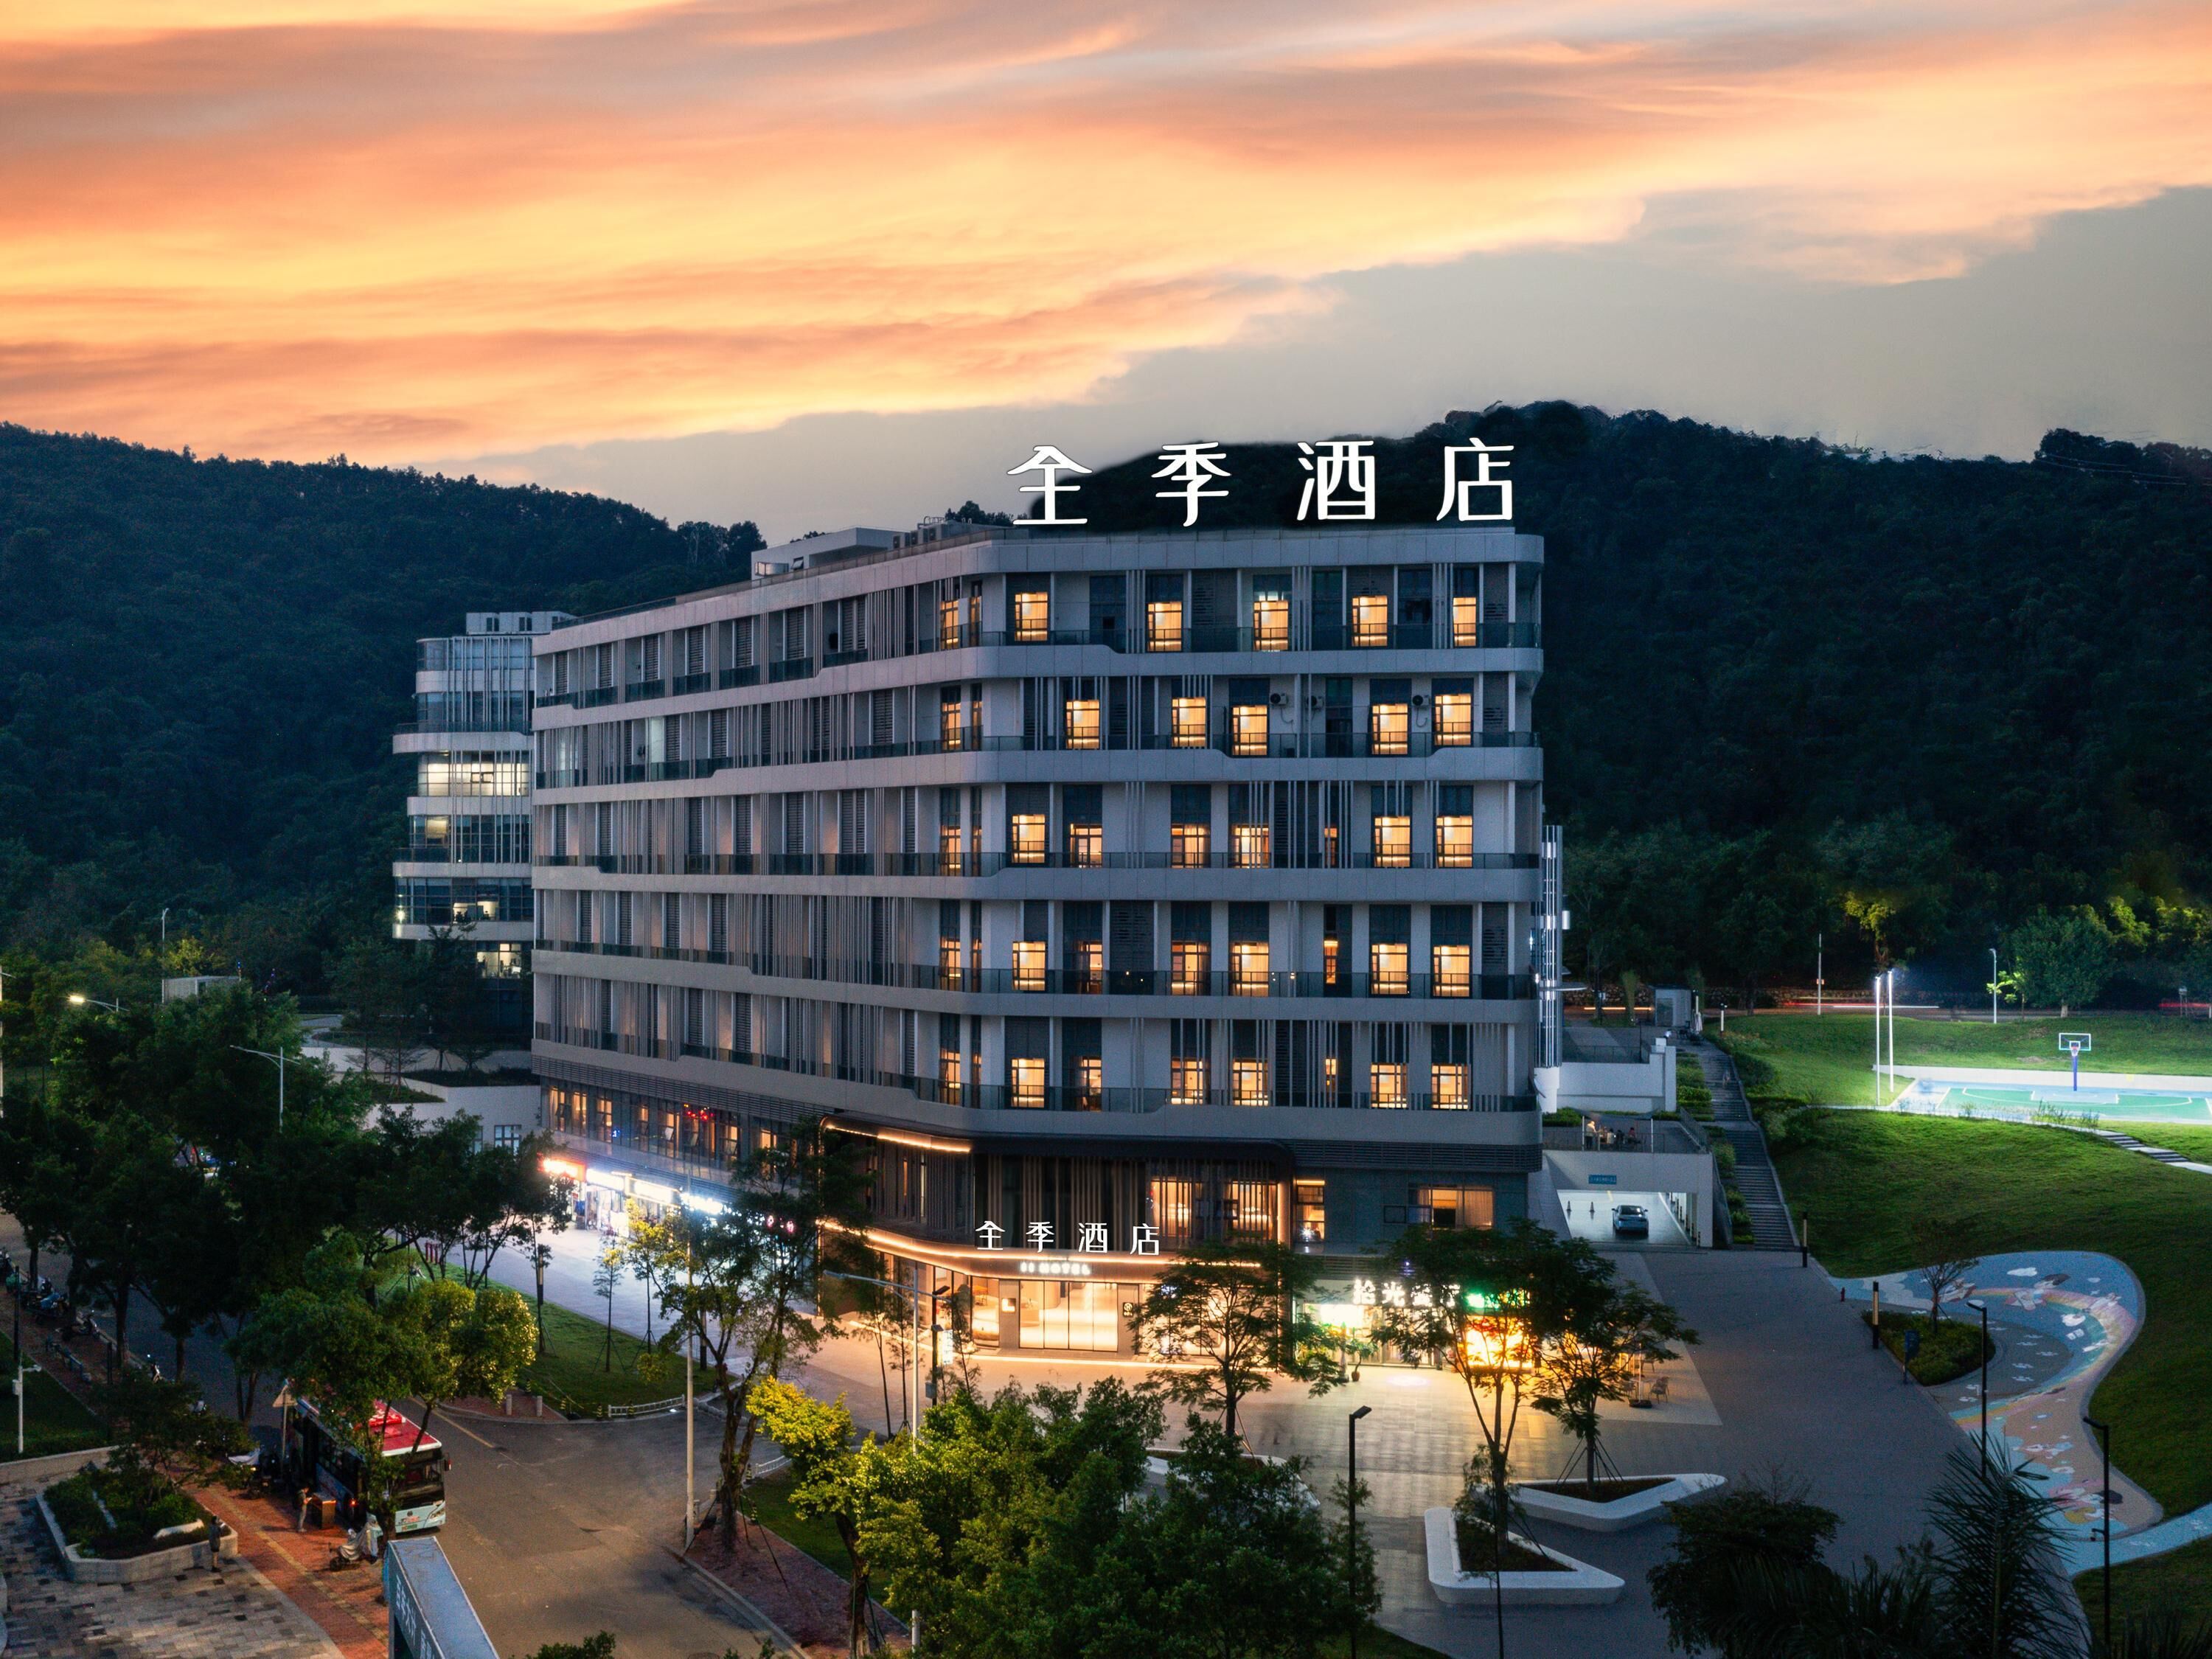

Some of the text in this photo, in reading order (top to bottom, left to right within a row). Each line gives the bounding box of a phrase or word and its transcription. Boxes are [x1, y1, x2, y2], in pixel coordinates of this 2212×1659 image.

[1007, 437, 1514, 527] 全季酒店
[975, 1220, 1160, 1255] 全季酒店
